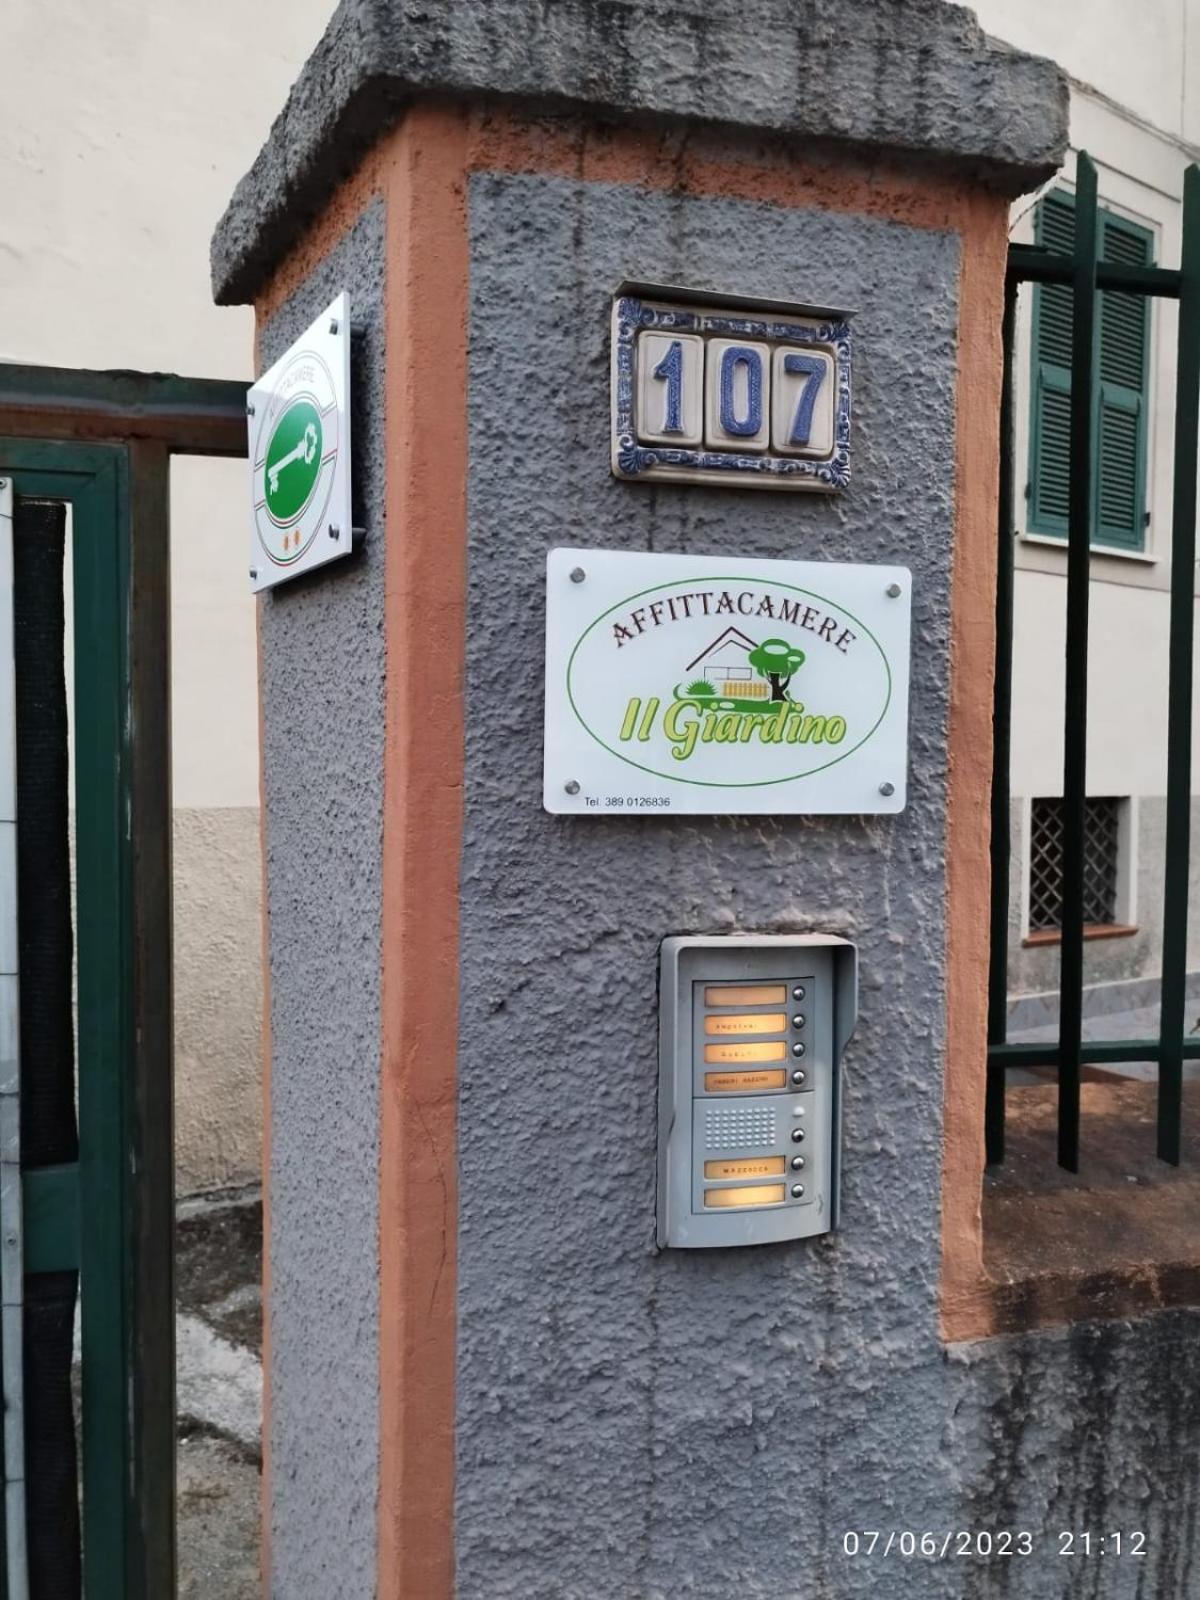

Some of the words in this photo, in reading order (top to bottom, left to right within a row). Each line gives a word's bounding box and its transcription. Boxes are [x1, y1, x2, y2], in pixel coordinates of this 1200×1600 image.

[653, 341, 827, 446] 107
[612, 591, 857, 654] AFFITTACAMERE
[620, 698, 660, 742] Il
[663, 698, 847, 760] Giardino
[605, 796, 624, 807] 389
[626, 796, 671, 807] 0126836
